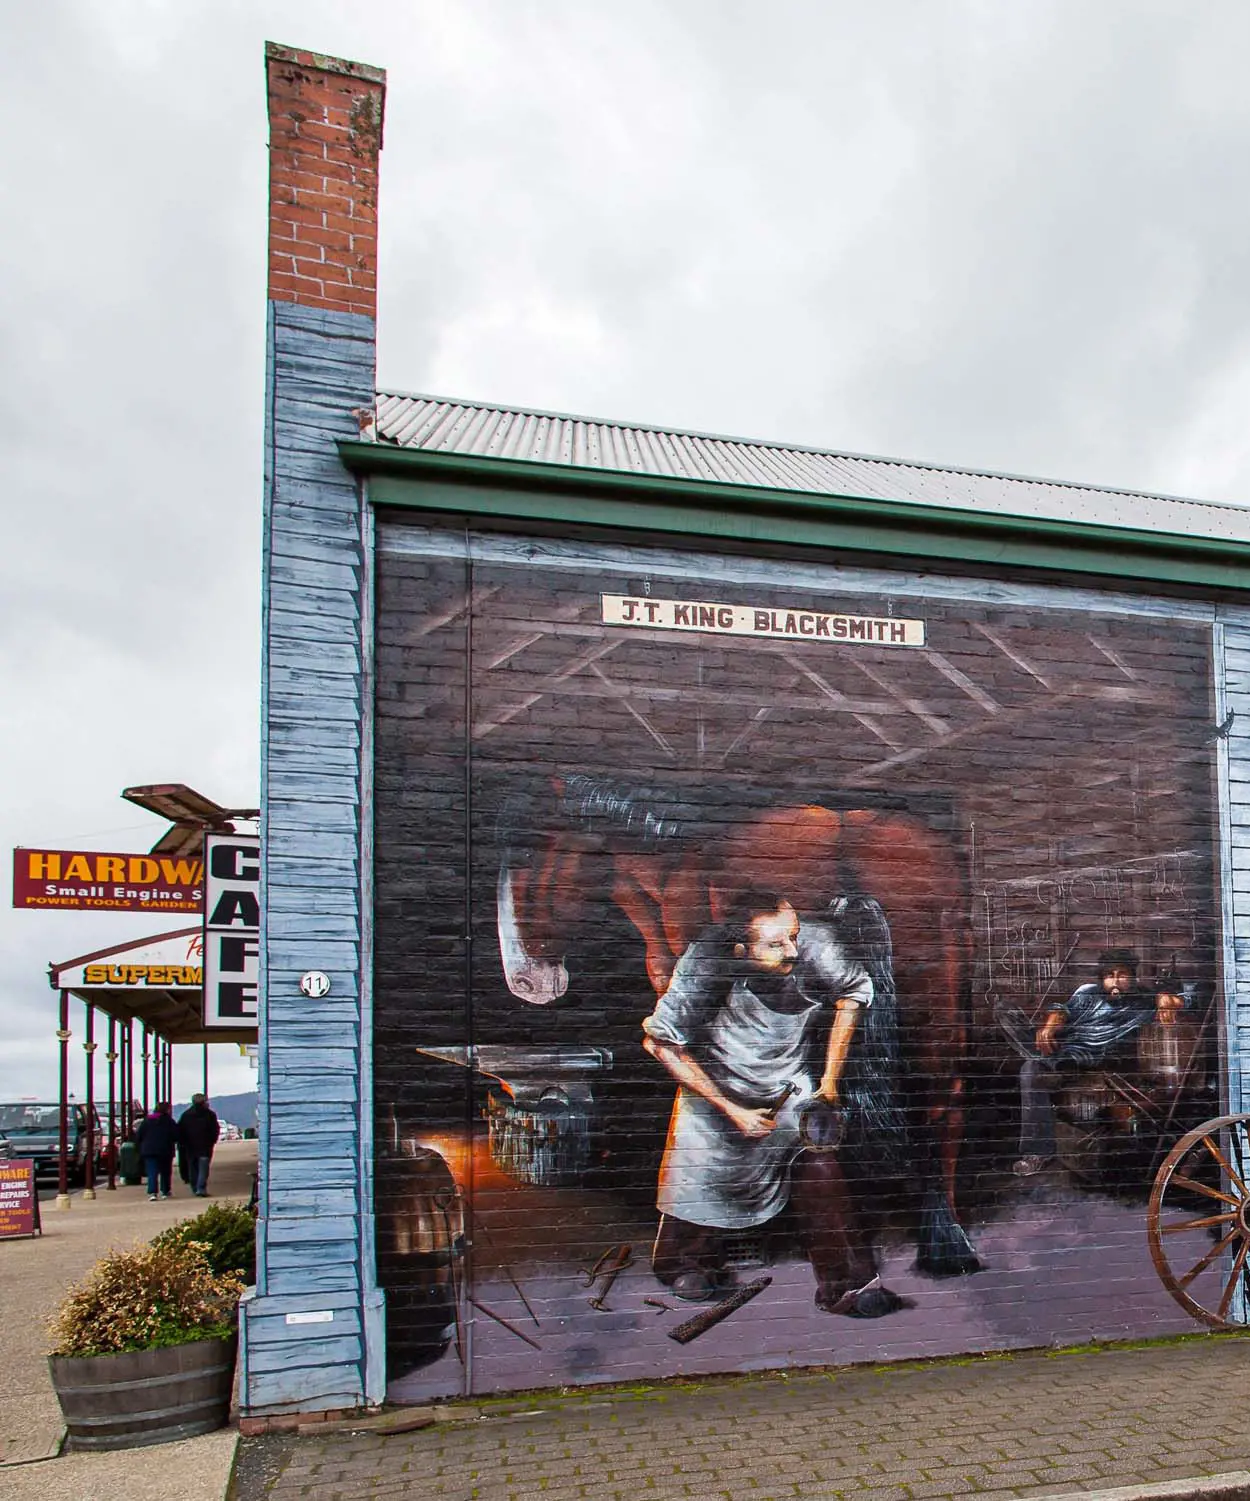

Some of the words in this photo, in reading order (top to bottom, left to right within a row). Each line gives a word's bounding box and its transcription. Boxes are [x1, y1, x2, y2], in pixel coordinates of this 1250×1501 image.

[622, 600, 662, 623] J.T.
[674, 604, 733, 628] KING
[754, 610, 906, 642] BLACKSMITH
[45, 884, 104, 897] Small
[114, 887, 183, 901] Engine
[26, 896, 80, 905] POWER
[85, 898, 131, 908] TOOLS
[140, 900, 198, 909] GARDEN
[208, 844, 260, 1018] CAFE
[305, 976, 322, 990] 11
